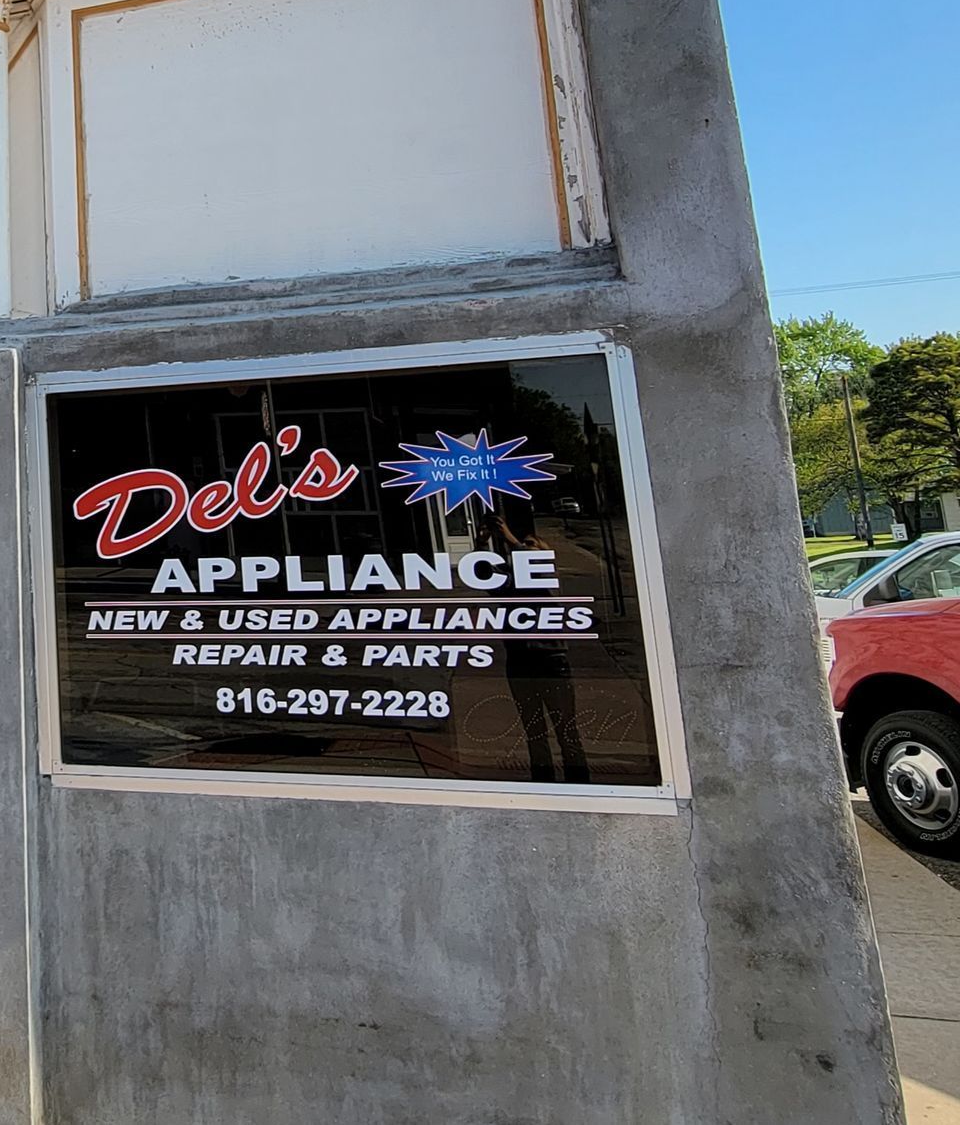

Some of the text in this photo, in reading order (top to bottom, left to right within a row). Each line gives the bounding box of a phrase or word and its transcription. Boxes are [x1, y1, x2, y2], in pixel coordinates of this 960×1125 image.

[430, 454, 495, 468] You Got It
[431, 471, 453, 482] We
[457, 469, 477, 481] Fix
[480, 469, 489, 480] It
[73, 425, 359, 559] Del's
[150, 550, 559, 593] APPLIANCE
[88, 607, 593, 630] NEW & USED APPLIANCES
[173, 644, 494, 667] REPAIR & PARTS
[216, 687, 450, 717] 816-297-2228
